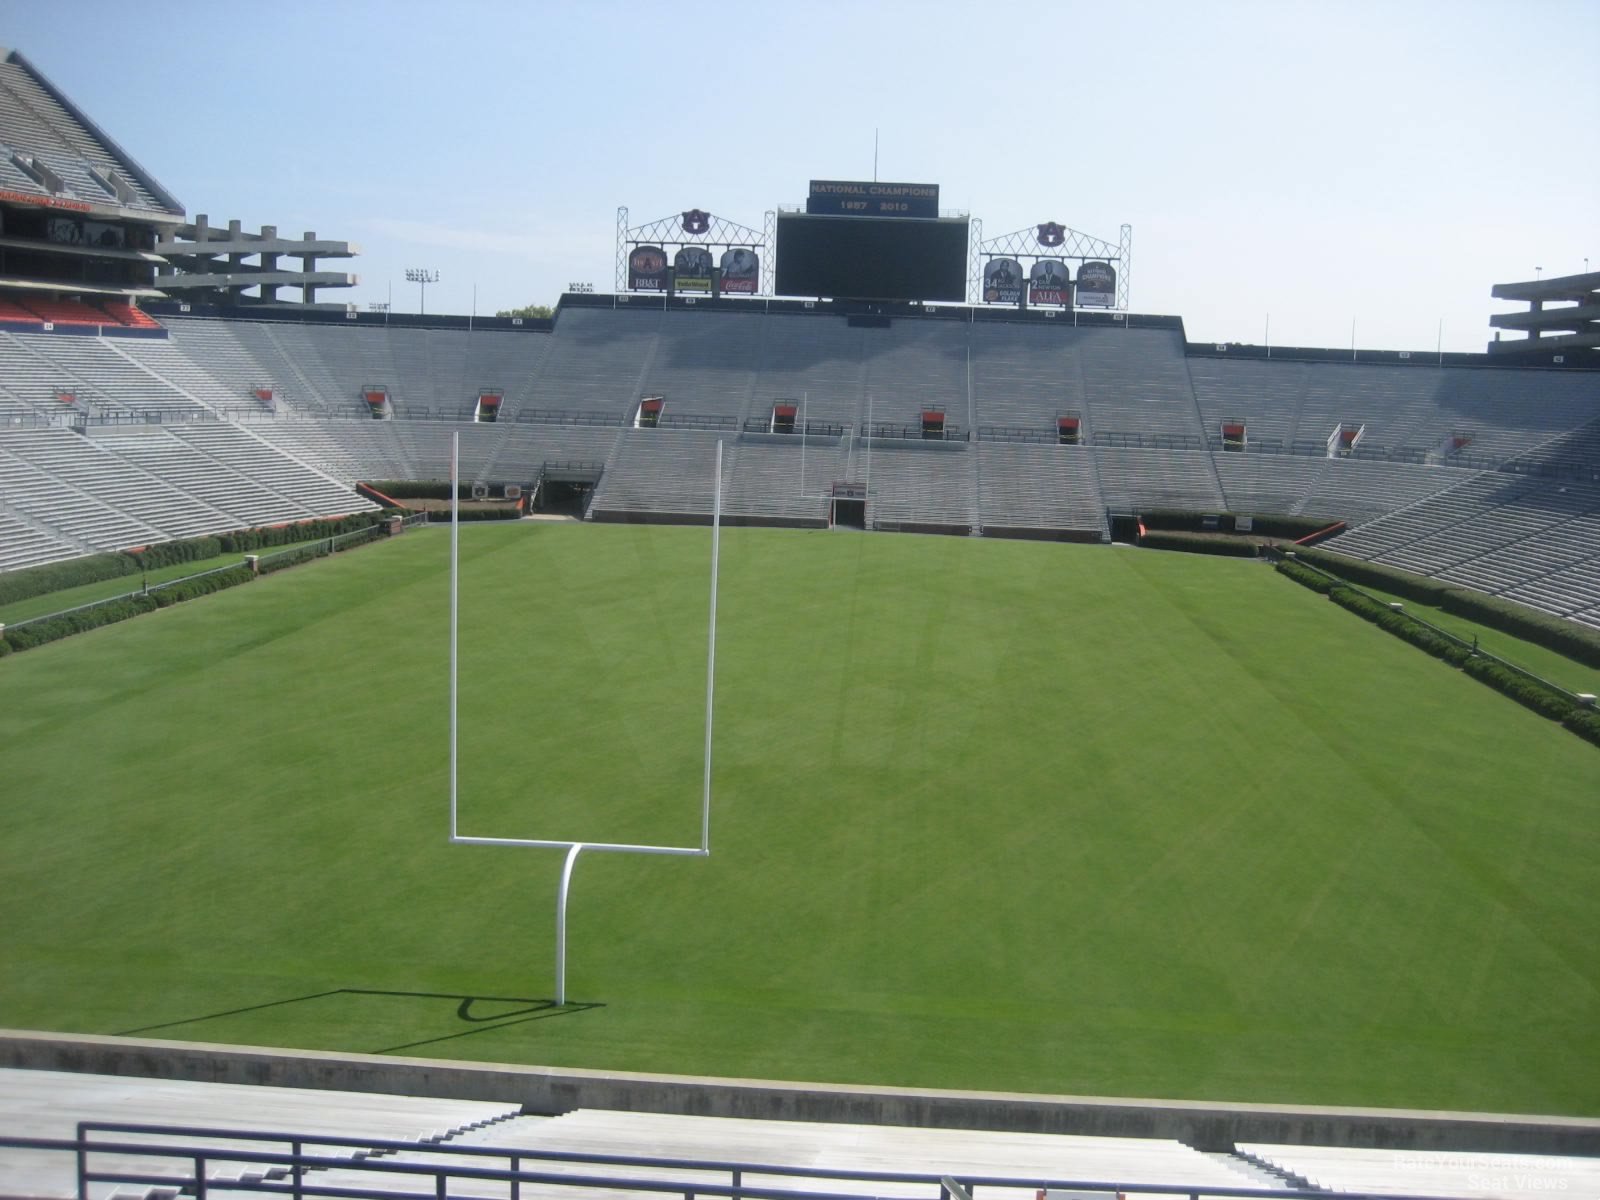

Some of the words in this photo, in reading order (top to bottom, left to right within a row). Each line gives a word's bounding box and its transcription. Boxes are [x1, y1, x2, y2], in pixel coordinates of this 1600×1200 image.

[812, 184, 866, 194] NATIONAL
[870, 186, 936, 197] CHAMPIONS
[880, 202, 909, 211] 2010
[635, 278, 660, 288] BB&T
